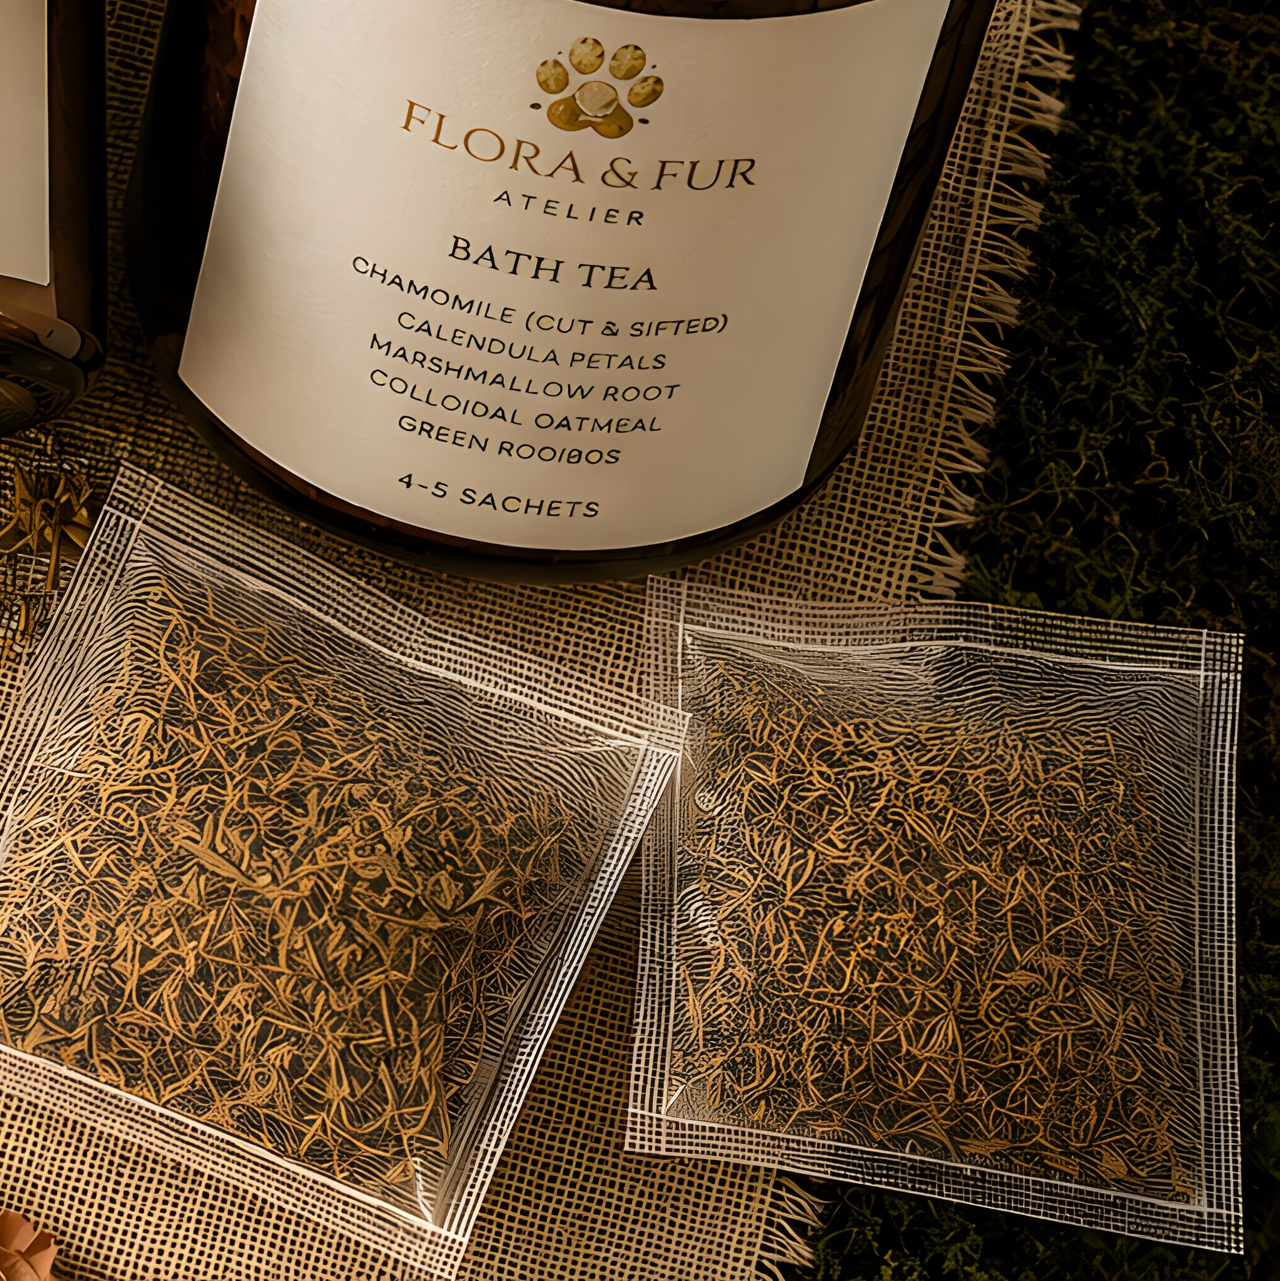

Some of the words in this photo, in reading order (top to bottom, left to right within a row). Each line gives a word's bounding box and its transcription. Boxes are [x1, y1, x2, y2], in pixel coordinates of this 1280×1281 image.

[400, 99, 585, 184] FLORA
[601, 157, 638, 189] &
[650, 159, 755, 190] FUR
[493, 190, 643, 225] ATELIER
[448, 235, 565, 283] BATH
[578, 264, 657, 290] TEA
[352, 255, 517, 324] CHAMOMILE
[526, 311, 593, 335] (CUT
[601, 321, 619, 336] &
[630, 314, 728, 337] SIFTED)
[370, 334, 595, 398] MARSHMALLOW
[603, 384, 681, 401] ROOT
[398, 311, 560, 366] CALENDULA
[570, 352, 666, 370] PETALS
[370, 368, 522, 426] COLLOIDAL
[535, 413, 661, 433] OATMEAL
[399, 415, 489, 452] GREEN
[398, 474, 448, 498] 4-5
[460, 488, 599, 517] SACHETS
